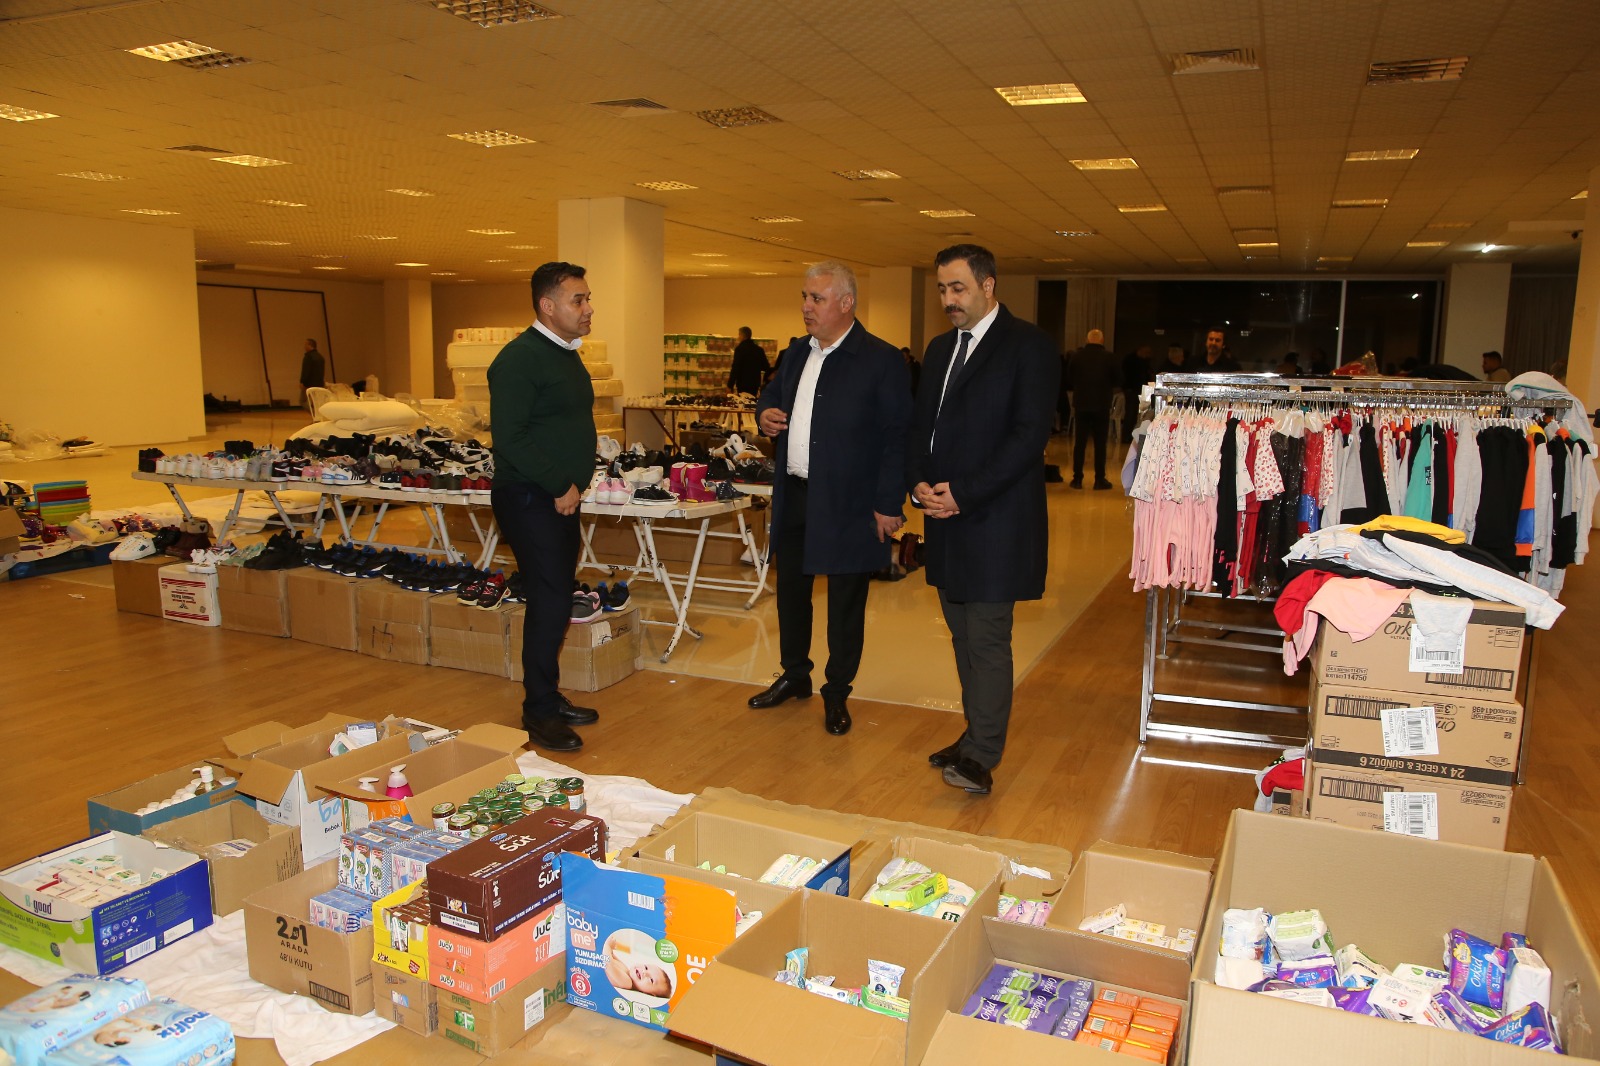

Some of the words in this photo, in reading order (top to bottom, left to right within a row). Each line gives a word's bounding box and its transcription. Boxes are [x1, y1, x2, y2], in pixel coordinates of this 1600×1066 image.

[1394, 604, 1405, 614] 4
[1384, 620, 1411, 636] Ork
[1435, 720, 1456, 732] Or
[1360, 756, 1367, 766] 6
[1369, 757, 1404, 770] GÜNDÜZ
[1407, 762, 1413, 770] &
[1416, 762, 1439, 772] GECE
[1451, 766, 1465, 778] 24
[500, 834, 536, 852] Süt
[535, 922, 550, 939] Juc
[567, 912, 598, 939] baby
[574, 933, 591, 946] me
[281, 940, 309, 955] ARADA
[574, 949, 610, 962] YUMUŞACIK
[293, 956, 313, 971] KUTU
[1470, 955, 1484, 988] Orkid
[981, 1001, 997, 1020] Orkid
[156, 1010, 212, 1039] molfix
[1495, 1019, 1522, 1041] Orkid
